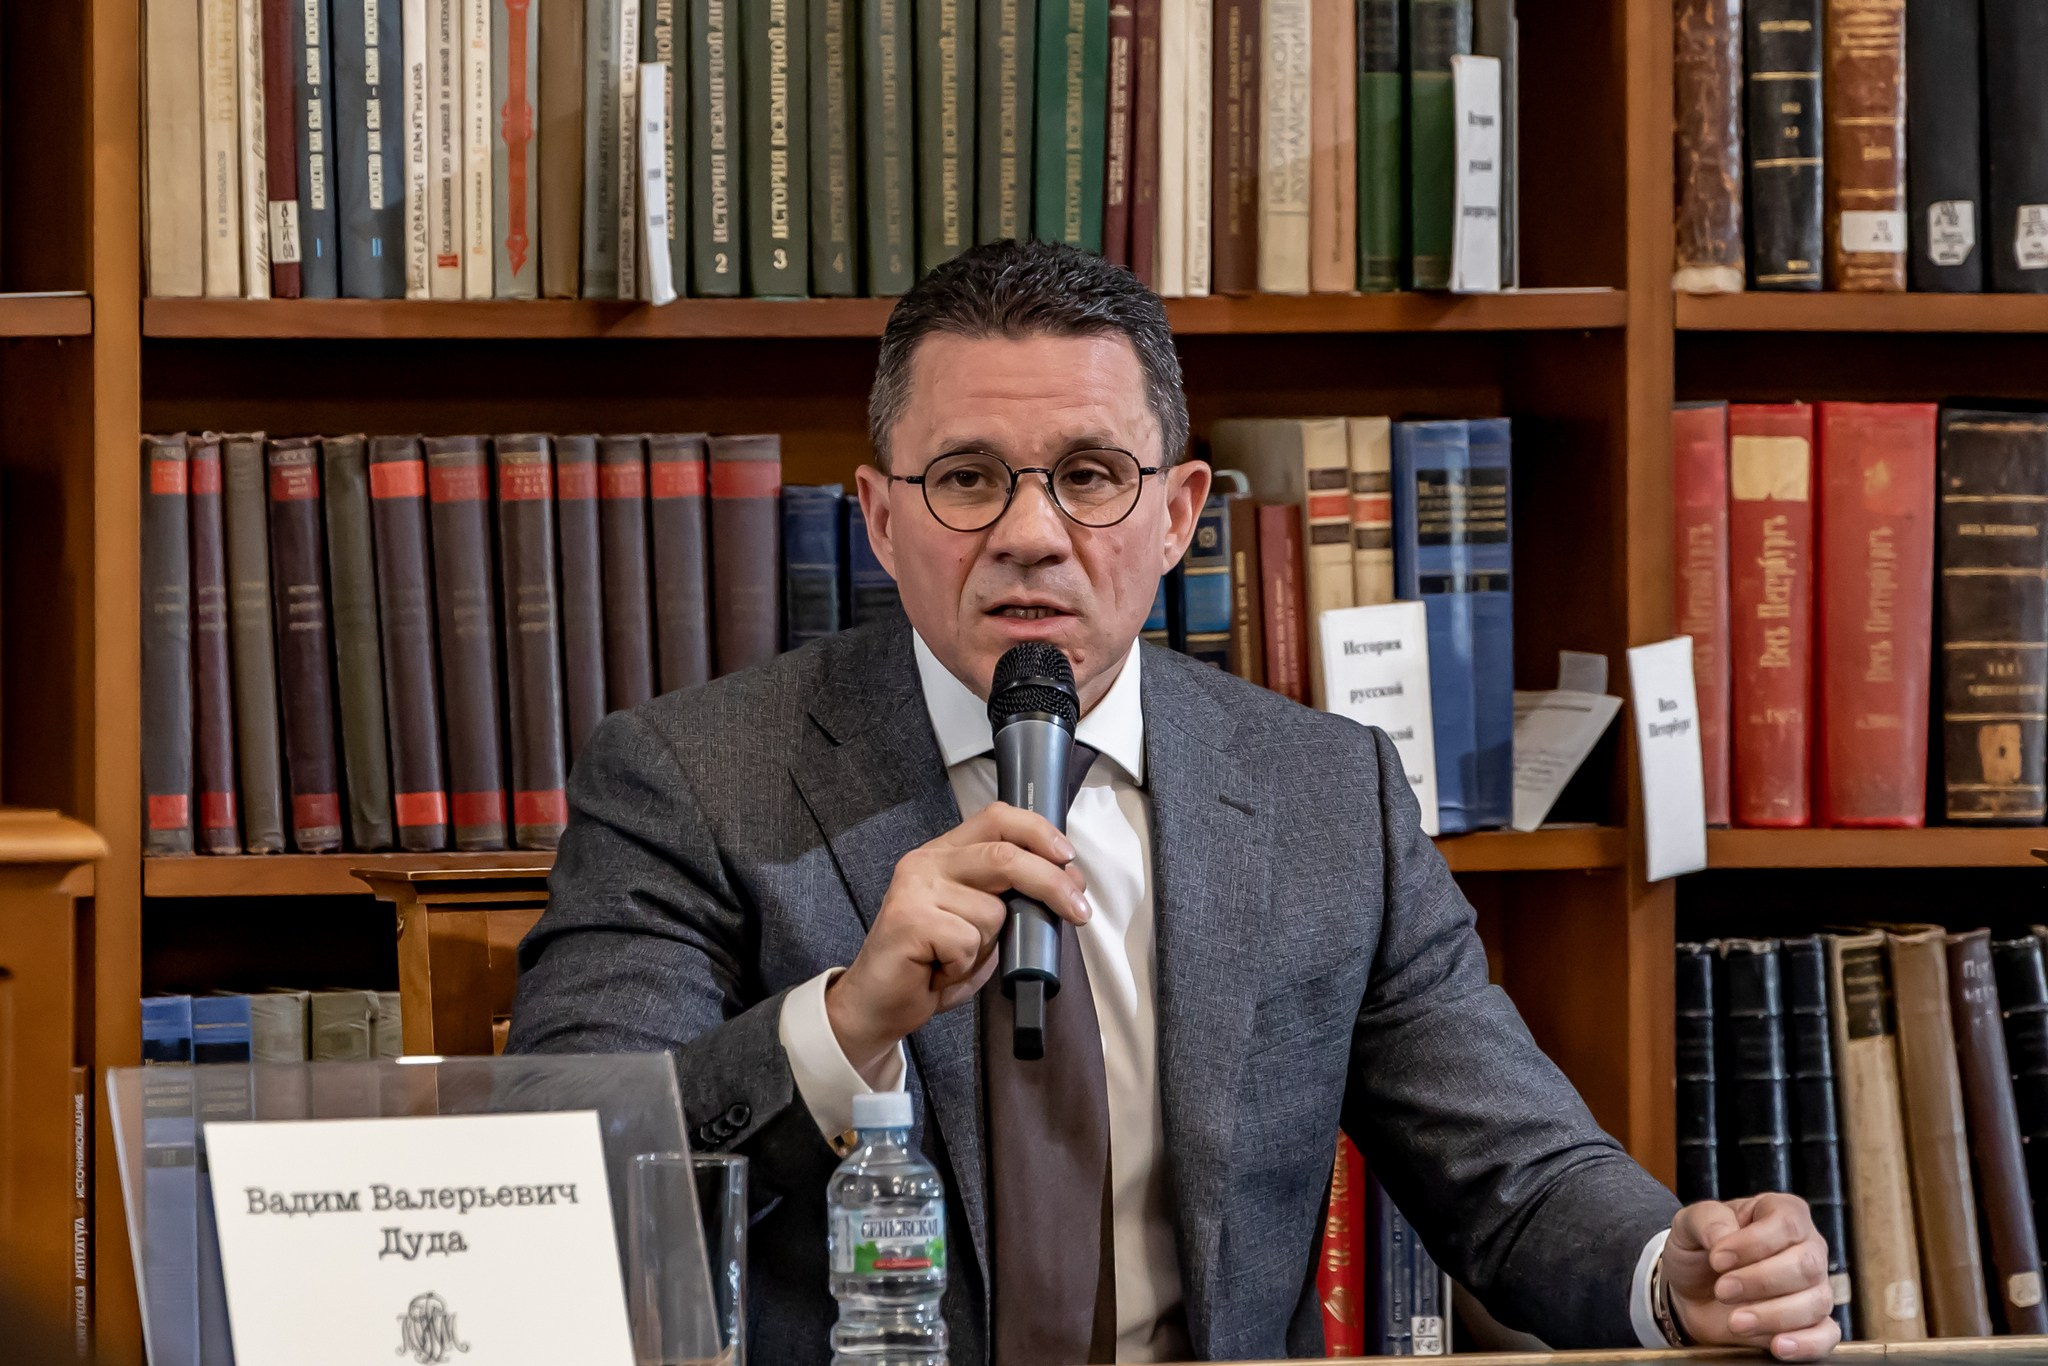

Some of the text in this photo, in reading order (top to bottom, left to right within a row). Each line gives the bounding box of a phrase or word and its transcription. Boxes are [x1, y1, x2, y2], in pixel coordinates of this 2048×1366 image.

[411, 63, 424, 163] ПАМЯТНИКОВ
[707, 32, 727, 150] ВСЕМИРНОЙ
[768, 27, 788, 147] ВСЕМИРНОЙ
[939, 37, 958, 154] ВСЕМИРНОЙ
[999, 37, 1016, 154] ВСЕМИРНОЙ
[1064, 33, 1083, 150] ВСЕМИРНОЙ
[711, 154, 729, 243] ИСТОРИЯ
[770, 150, 789, 239] ИСТОРИЯ
[943, 157, 960, 246] ИСТОРИЯ
[1064, 154, 1081, 242] ИСТОРИЯ
[714, 252, 729, 273] 2
[773, 248, 788, 270] 3
[832, 252, 845, 273] 4
[1343, 639, 1403, 656] История
[1350, 681, 1404, 704] русской
[73, 1094, 86, 1199] ИСТОЧНИКОВЕДЕНИЕ
[244, 1182, 580, 1218] Вадим Валерьевич
[378, 1227, 468, 1261] Дуда
[74, 1217, 88, 1280] ЛИТЕРАТУРА
